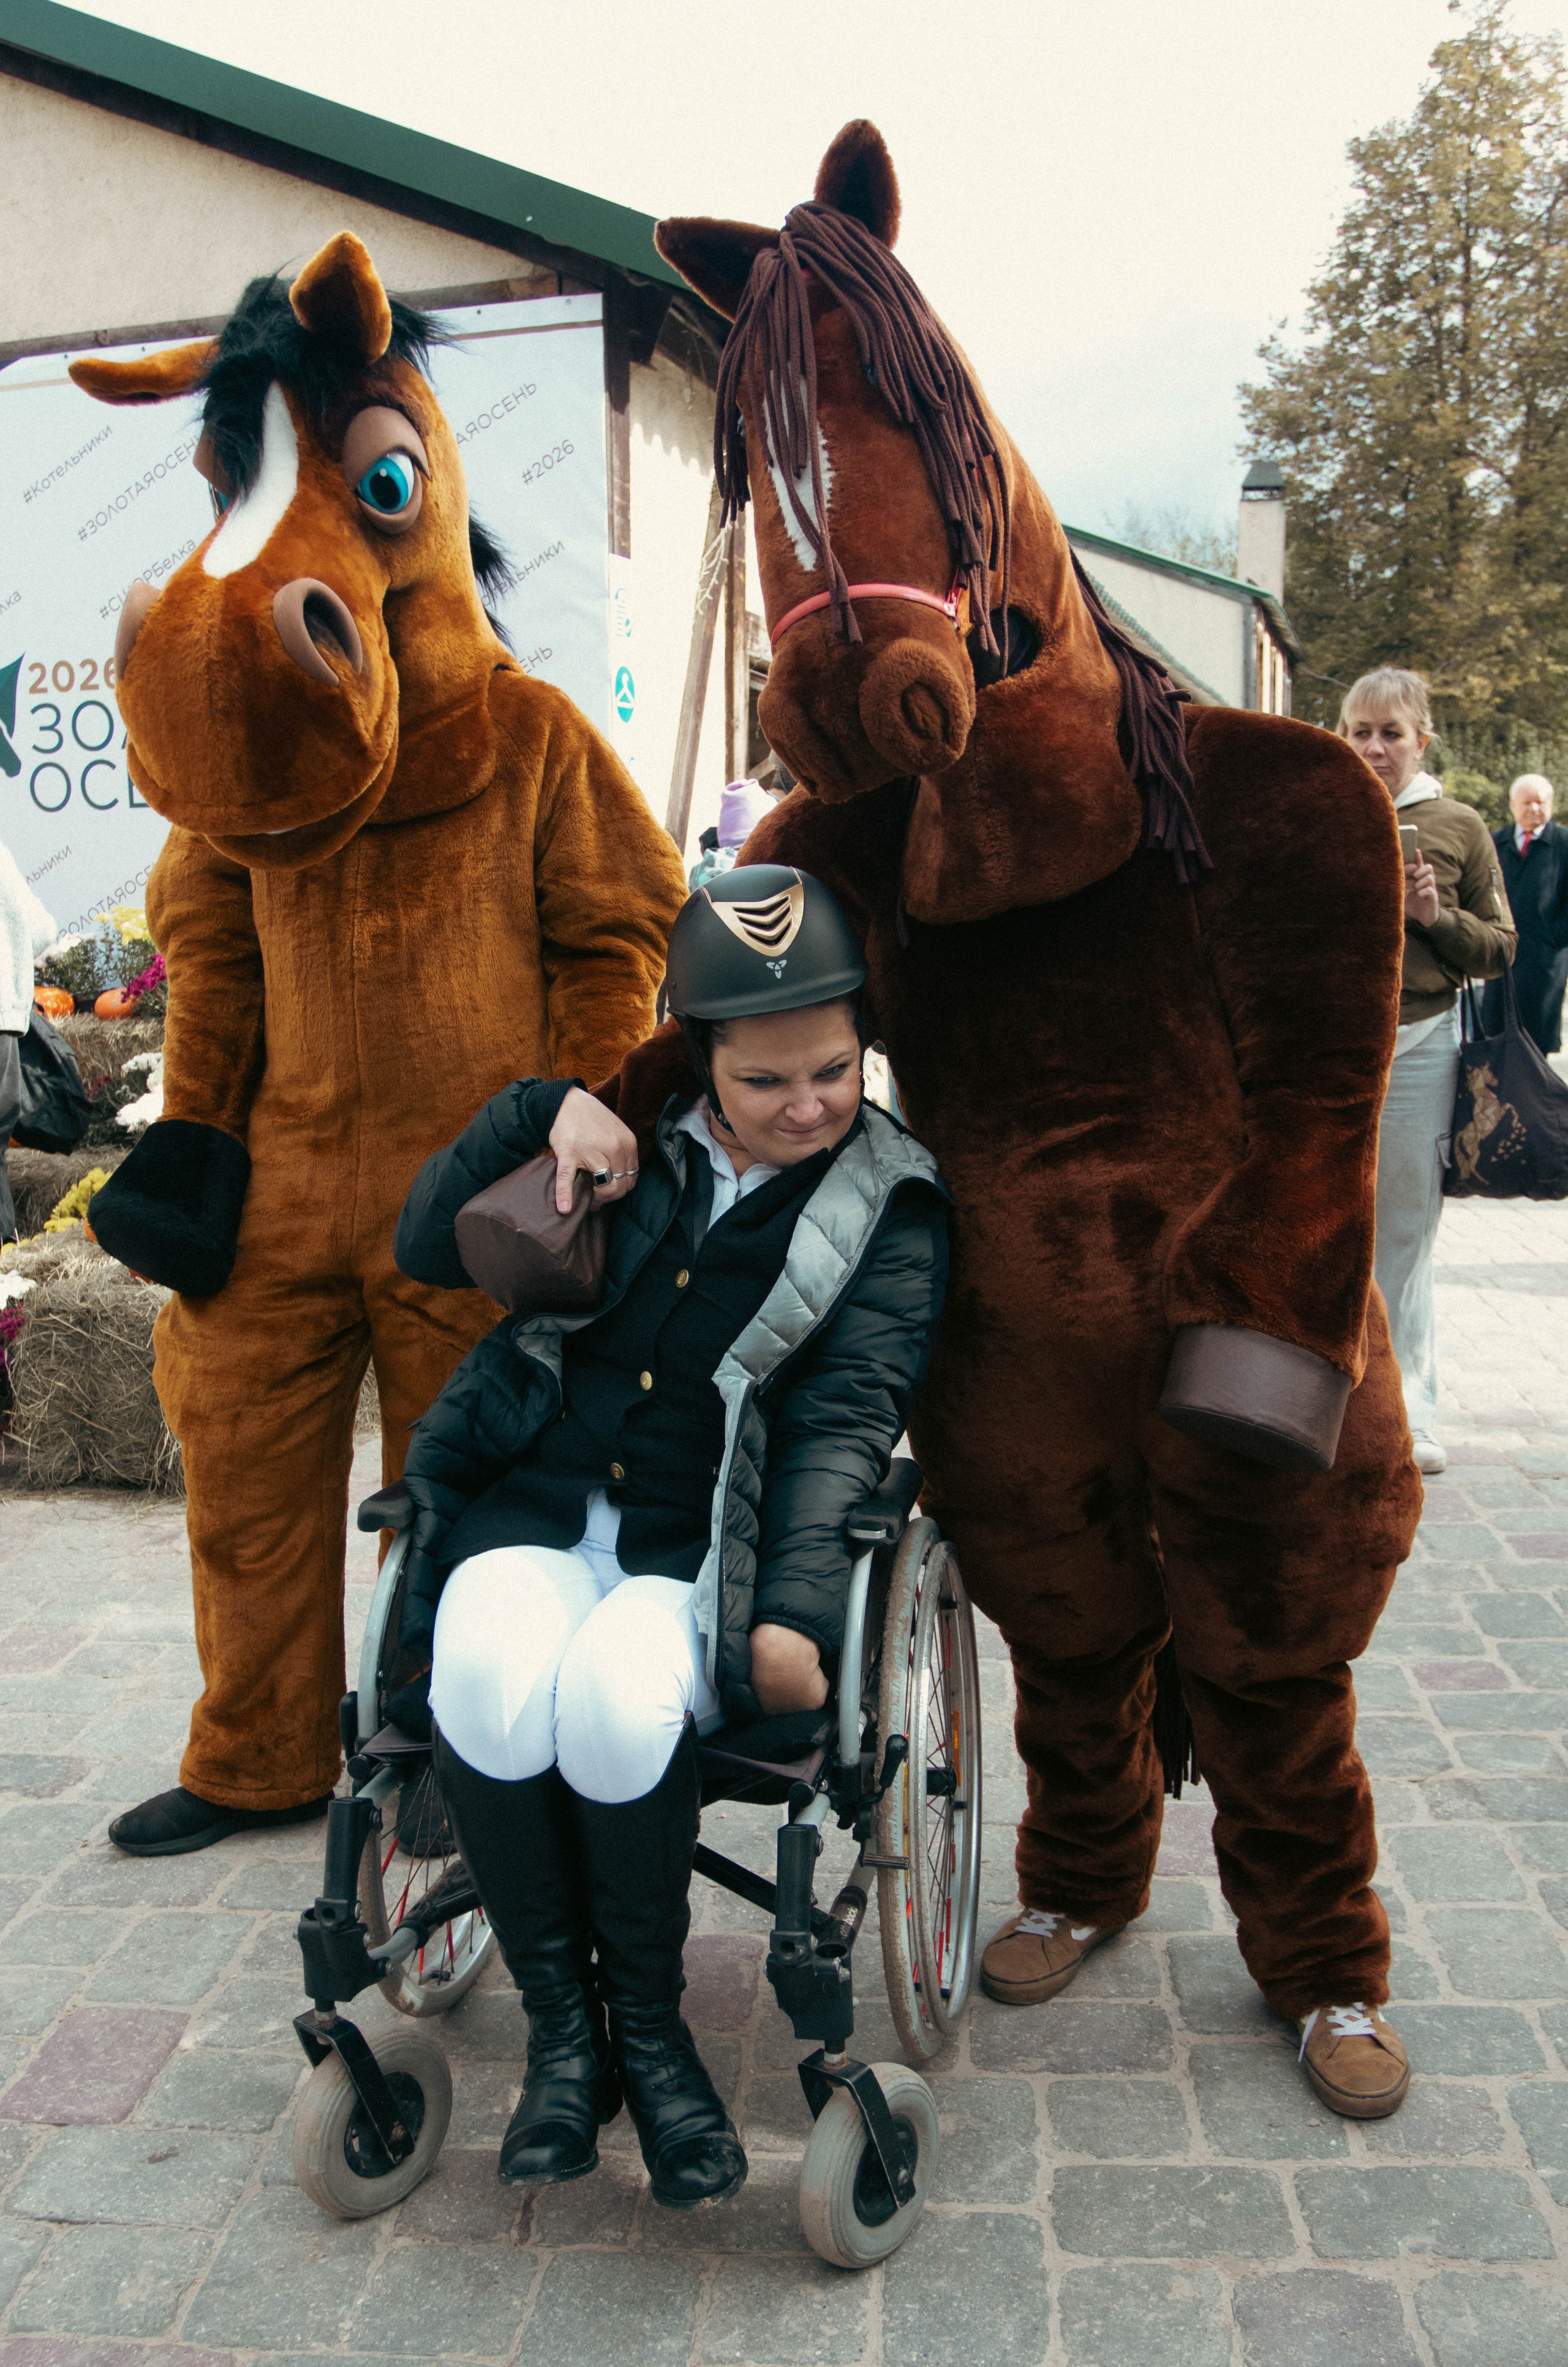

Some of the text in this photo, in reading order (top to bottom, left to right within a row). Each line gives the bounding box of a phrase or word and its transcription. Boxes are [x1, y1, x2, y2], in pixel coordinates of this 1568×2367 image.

[23, 425, 113, 504] #Котельники
[78, 435, 198, 542] #ЗОЛОТАЯОСЕН
[522, 439, 575, 485] #2026
[30, 700, 127, 754] ЗО
